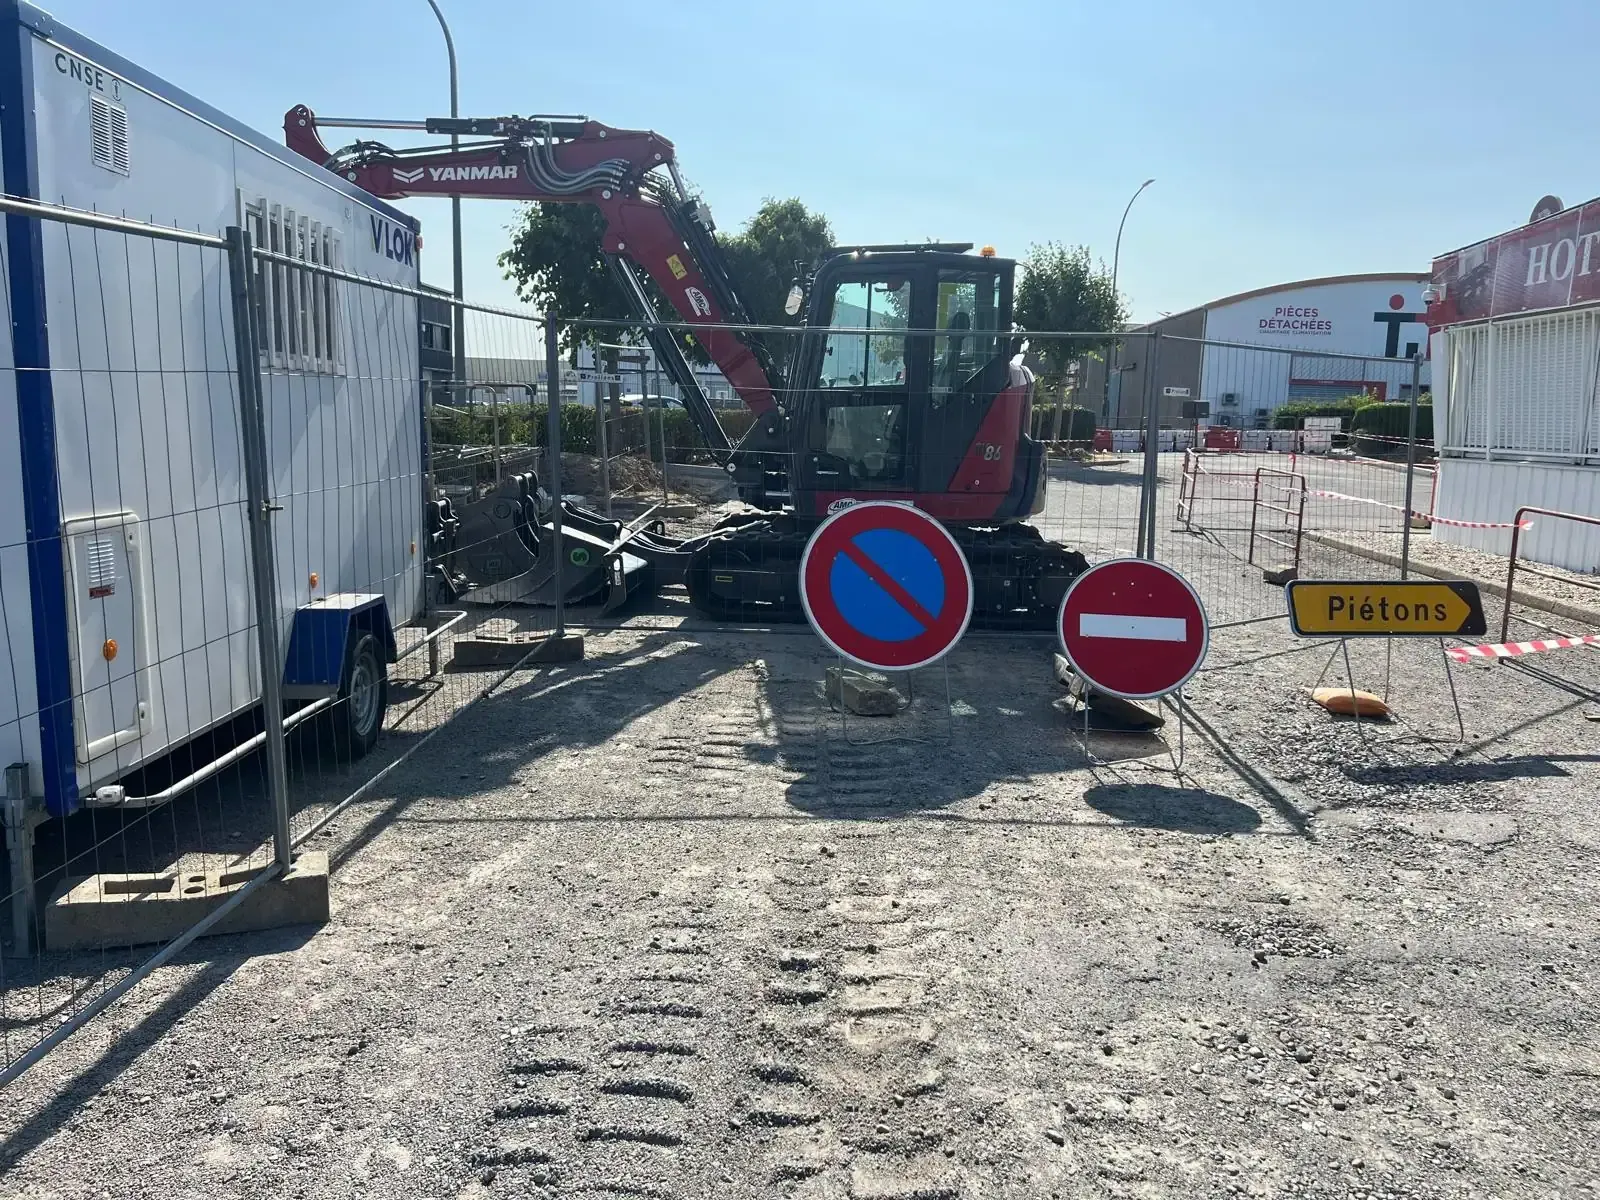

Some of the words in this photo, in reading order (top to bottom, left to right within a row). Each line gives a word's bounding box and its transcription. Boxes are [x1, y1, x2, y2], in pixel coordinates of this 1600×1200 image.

[55, 52, 104, 92] CNSE
[429, 165, 518, 182] YANMAR
[1524, 231, 1600, 287] HOT
[1275, 304, 1319, 318] PIÈCES
[1259, 316, 1332, 330] DÉTACHÉES
[1328, 595, 1447, 621] Piétons
